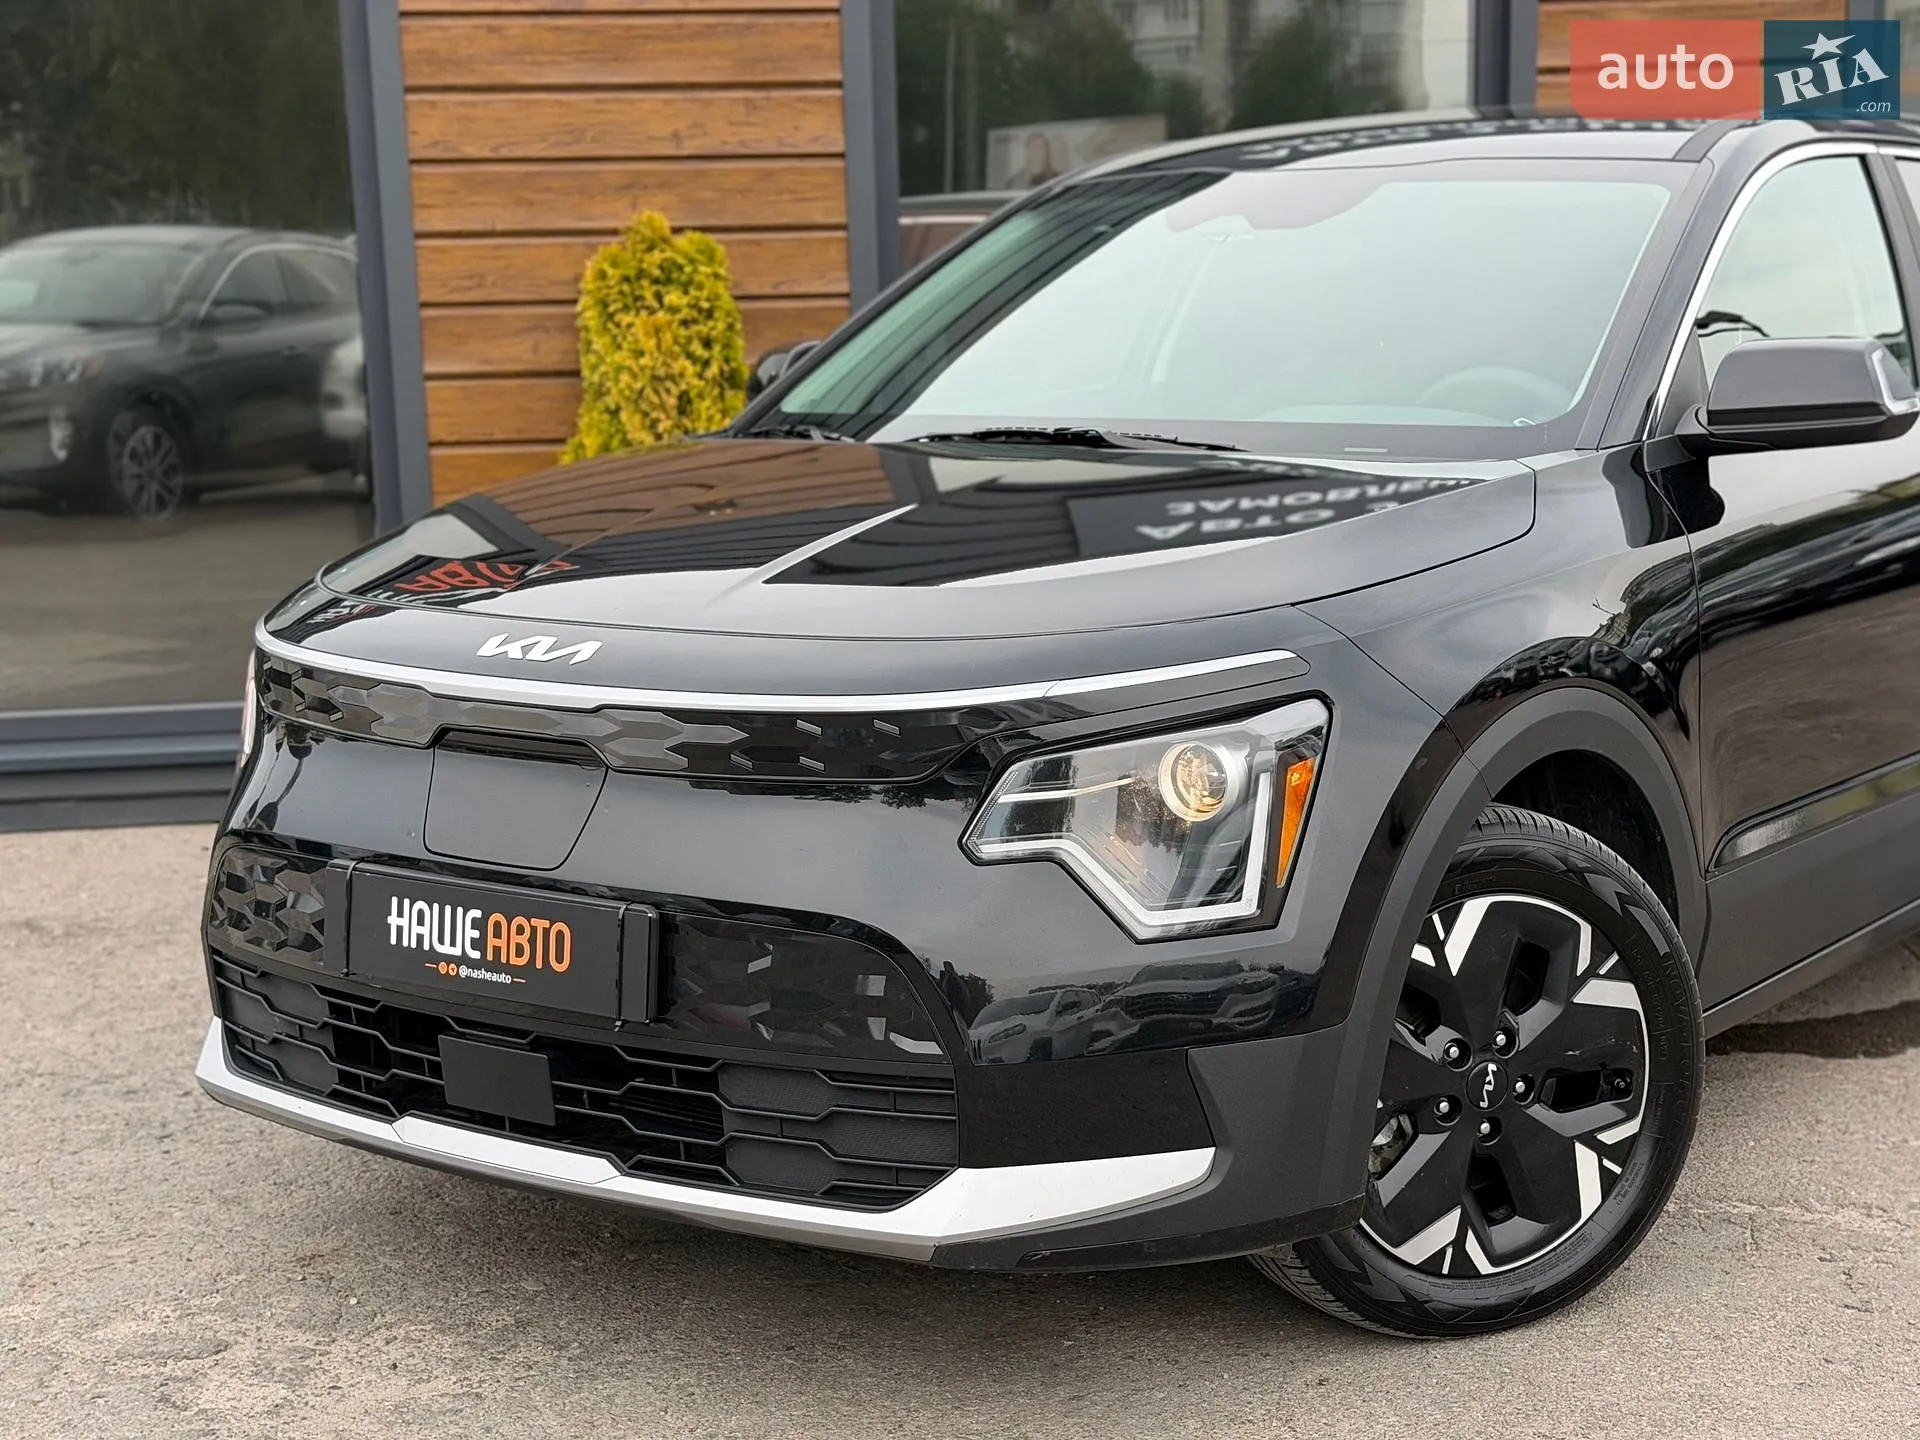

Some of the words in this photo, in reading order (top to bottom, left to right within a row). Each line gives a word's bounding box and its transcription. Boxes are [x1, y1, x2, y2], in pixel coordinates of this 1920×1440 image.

[476, 632, 603, 666] KIA
[387, 895, 483, 960] НАШЕ
[486, 911, 572, 973] АВТО
[458, 964, 512, 984] @nasheauto
